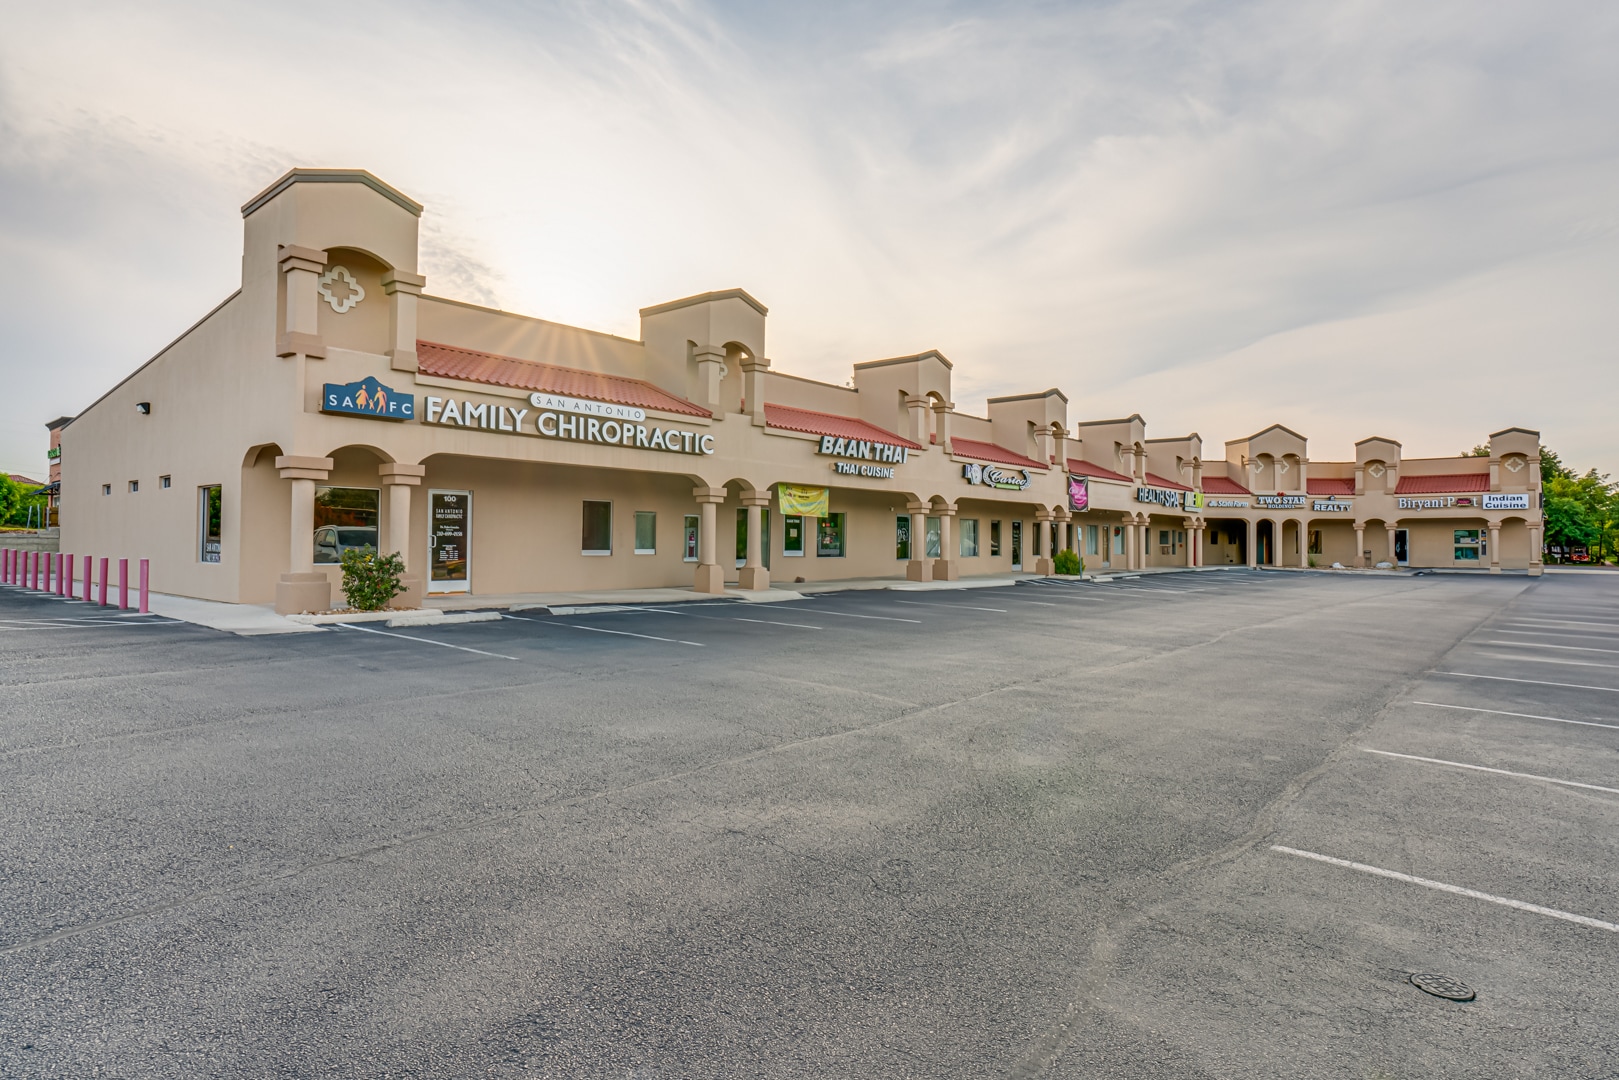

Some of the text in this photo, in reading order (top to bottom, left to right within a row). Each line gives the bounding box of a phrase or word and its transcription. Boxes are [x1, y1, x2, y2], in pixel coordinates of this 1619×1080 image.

[536, 395, 641, 419] SAN ANTONIO
[426, 396, 715, 455] FAMILY CHIROPRACTIC
[820, 435, 909, 464] BAAN THAI
[837, 462, 895, 479] THAI CUISINE
[1139, 487, 1179, 508] HEALTH SPA
[1258, 496, 1281, 504] TWO
[1282, 496, 1306, 504] STAR
[1399, 497, 1444, 511] Biryani
[1313, 504, 1352, 512] REALTY
